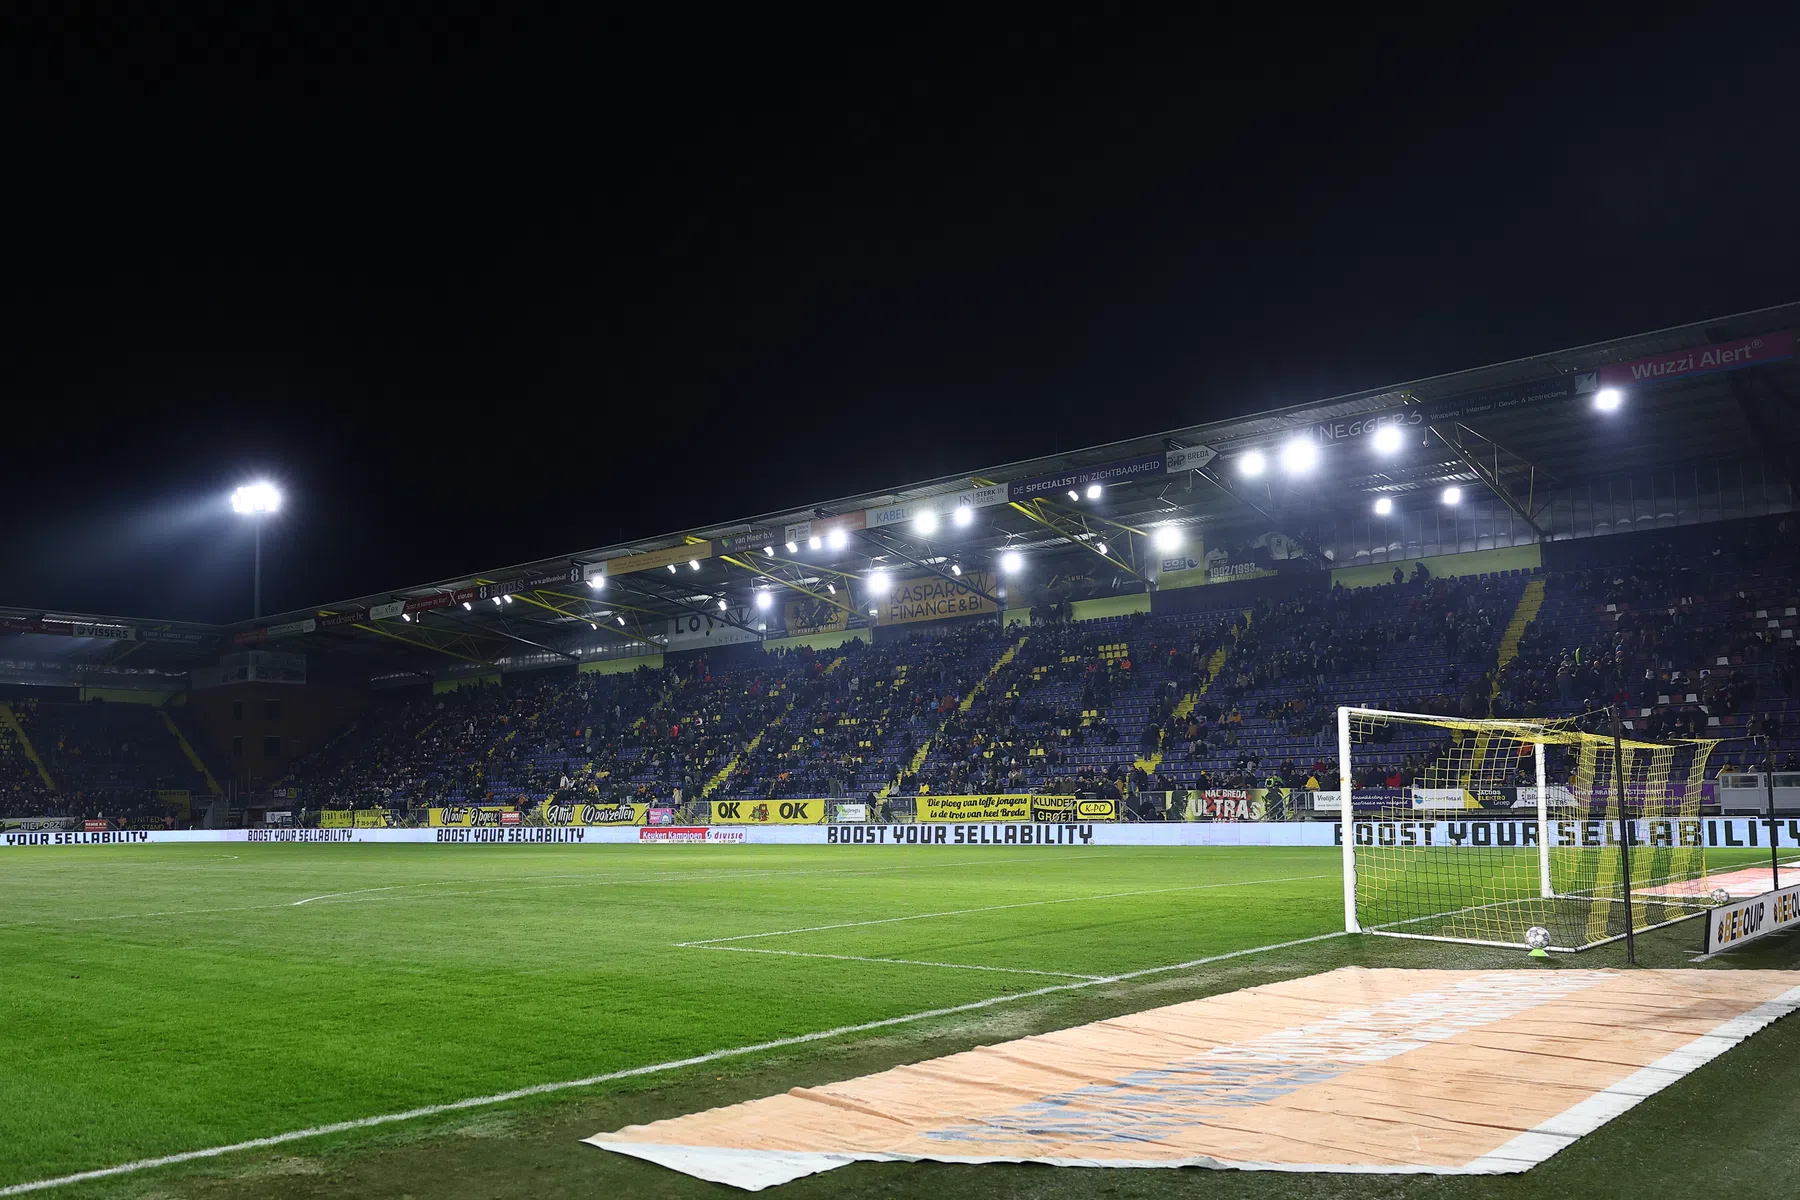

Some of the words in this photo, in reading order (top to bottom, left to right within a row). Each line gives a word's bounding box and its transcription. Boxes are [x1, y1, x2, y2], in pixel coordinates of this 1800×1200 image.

[1632, 353, 1694, 380] Wuzzi
[1430, 409, 1460, 420] Wrapping
[1319, 409, 1424, 441] NEGGERS
[1187, 449, 1210, 461] BREDA
[1013, 486, 1024, 496] DE
[1025, 476, 1077, 493] SPECIALIST
[1079, 473, 1089, 483] IN
[1091, 460, 1160, 482] ZICHTBAARHEID
[976, 489, 996, 499] STERK
[996, 487, 1005, 496] IN
[1209, 562, 1257, 578] 1992/1993
[891, 575, 988, 605] KASPAROW
[891, 598, 957, 621] FINANCE
[958, 599, 968, 611] &
[969, 595, 984, 611] BI
[88, 626, 128, 639] VISSERS
[714, 634, 750, 645] INTERIM
[1205, 790, 1221, 798] NAC
[1222, 789, 1248, 799] BREDA
[717, 801, 741, 819] OK
[778, 801, 809, 819] OK
[927, 798, 941, 807] Die
[940, 798, 961, 810] ploeg
[962, 798, 978, 807] van
[978, 797, 996, 809] toffe
[995, 796, 1028, 808] jongens
[1085, 803, 1107, 813] K-PO
[1192, 798, 1262, 820] ULTRAS
[441, 807, 469, 825] Nooit
[547, 804, 575, 826] Altijd
[581, 804, 635, 823] Doorzetten
[930, 810, 938, 818] is
[938, 810, 948, 818] de
[948, 809, 966, 819] trots
[966, 810, 982, 818] van
[983, 809, 1000, 818] heel
[999, 808, 1026, 817] Breda
[20, 821, 40, 831] NIET
[6, 834, 50, 846] YOUR
[55, 831, 148, 845] SELLABILITY
[248, 830, 272, 842] BOOST
[274, 830, 297, 842] YOUR
[299, 829, 353, 842] SELLABILITY
[437, 828, 471, 842] BOOST
[474, 828, 504, 842] YOUR
[508, 827, 585, 843] SELLABILITY
[643, 831, 667, 840] Keuken
[668, 830, 703, 841] Kampioen
[714, 830, 743, 840] divisie
[828, 826, 887, 843] BOOST
[893, 825, 947, 844] YOUR
[954, 825, 1092, 844] SELLABILITY
[1448, 822, 1539, 846] YOUR
[1724, 902, 1765, 943] BEEQUIP
